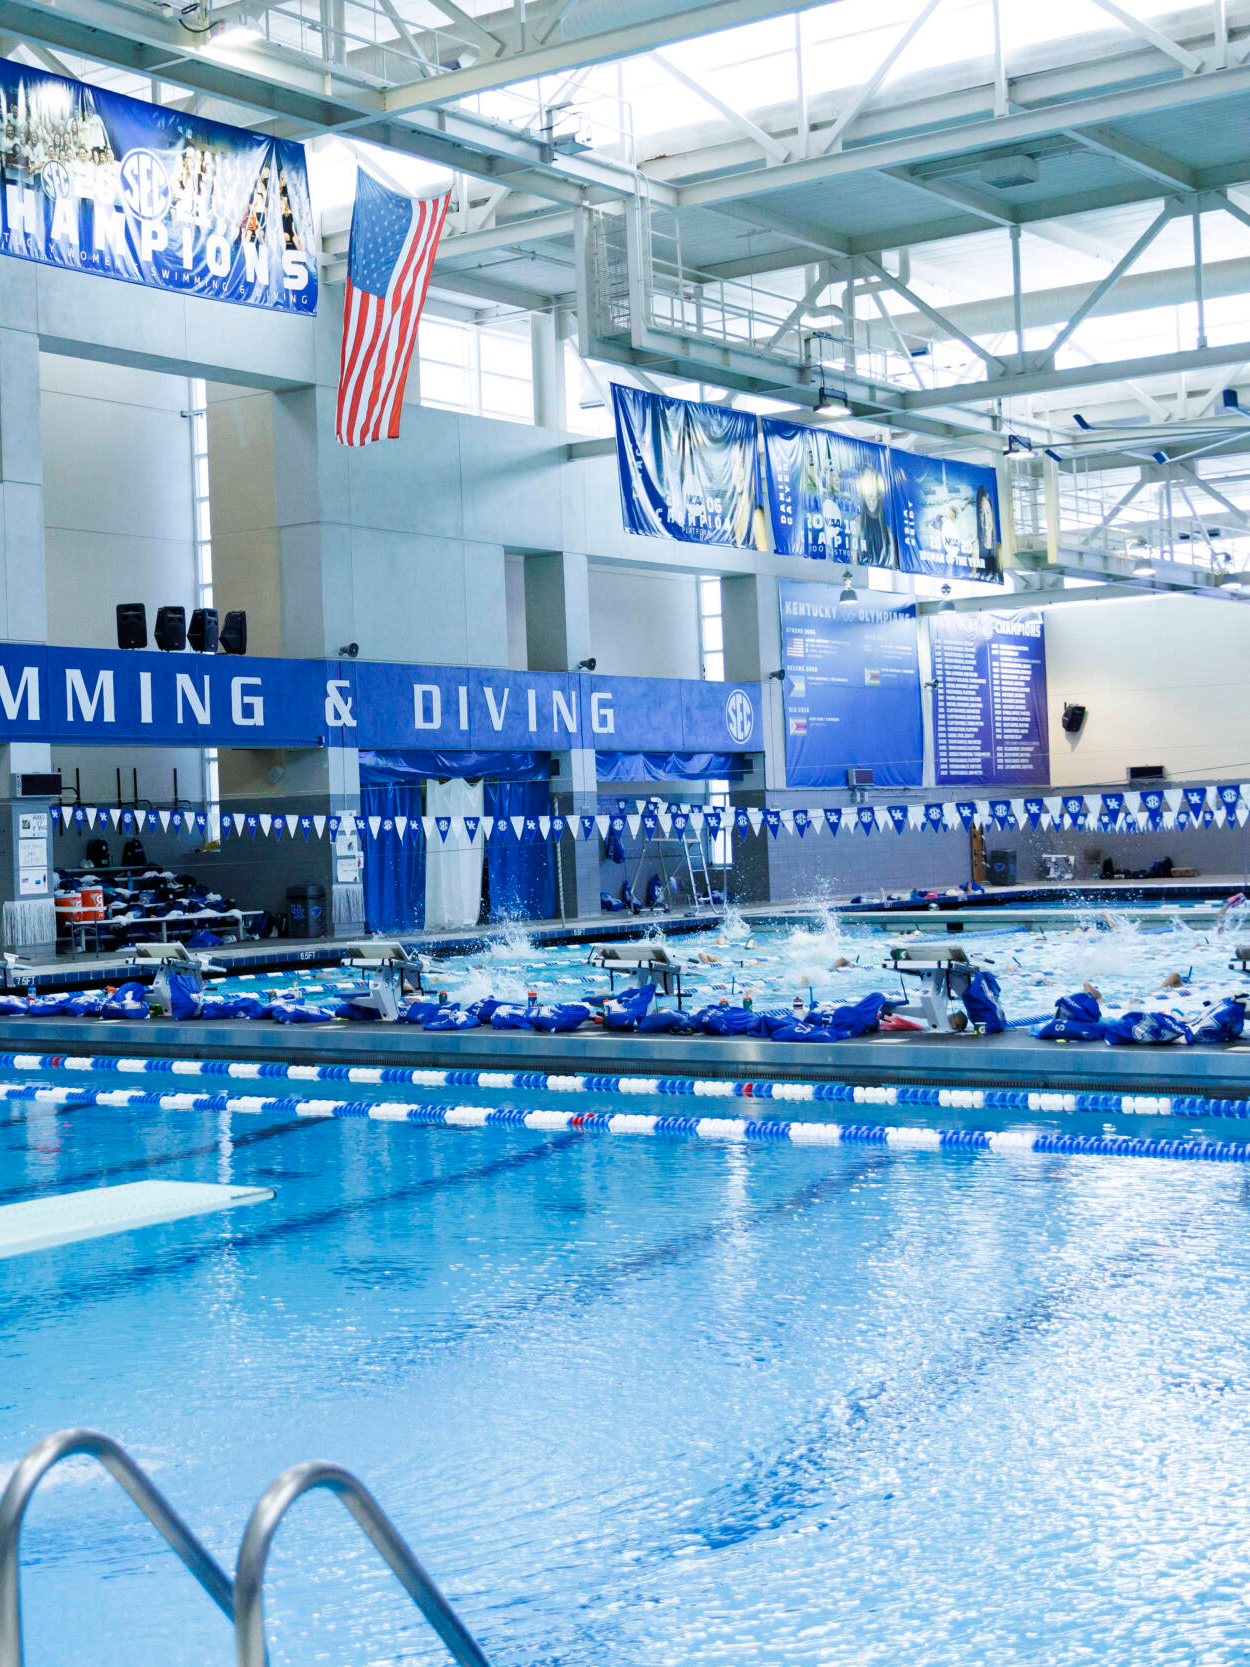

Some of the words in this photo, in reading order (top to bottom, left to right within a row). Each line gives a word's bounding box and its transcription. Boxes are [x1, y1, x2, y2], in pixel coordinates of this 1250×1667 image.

[120, 148, 172, 222] SEC
[785, 600, 837, 619] KENTUCKY
[325, 680, 358, 727] &
[414, 684, 616, 734] DIVING
[726, 689, 754, 744] SEC
